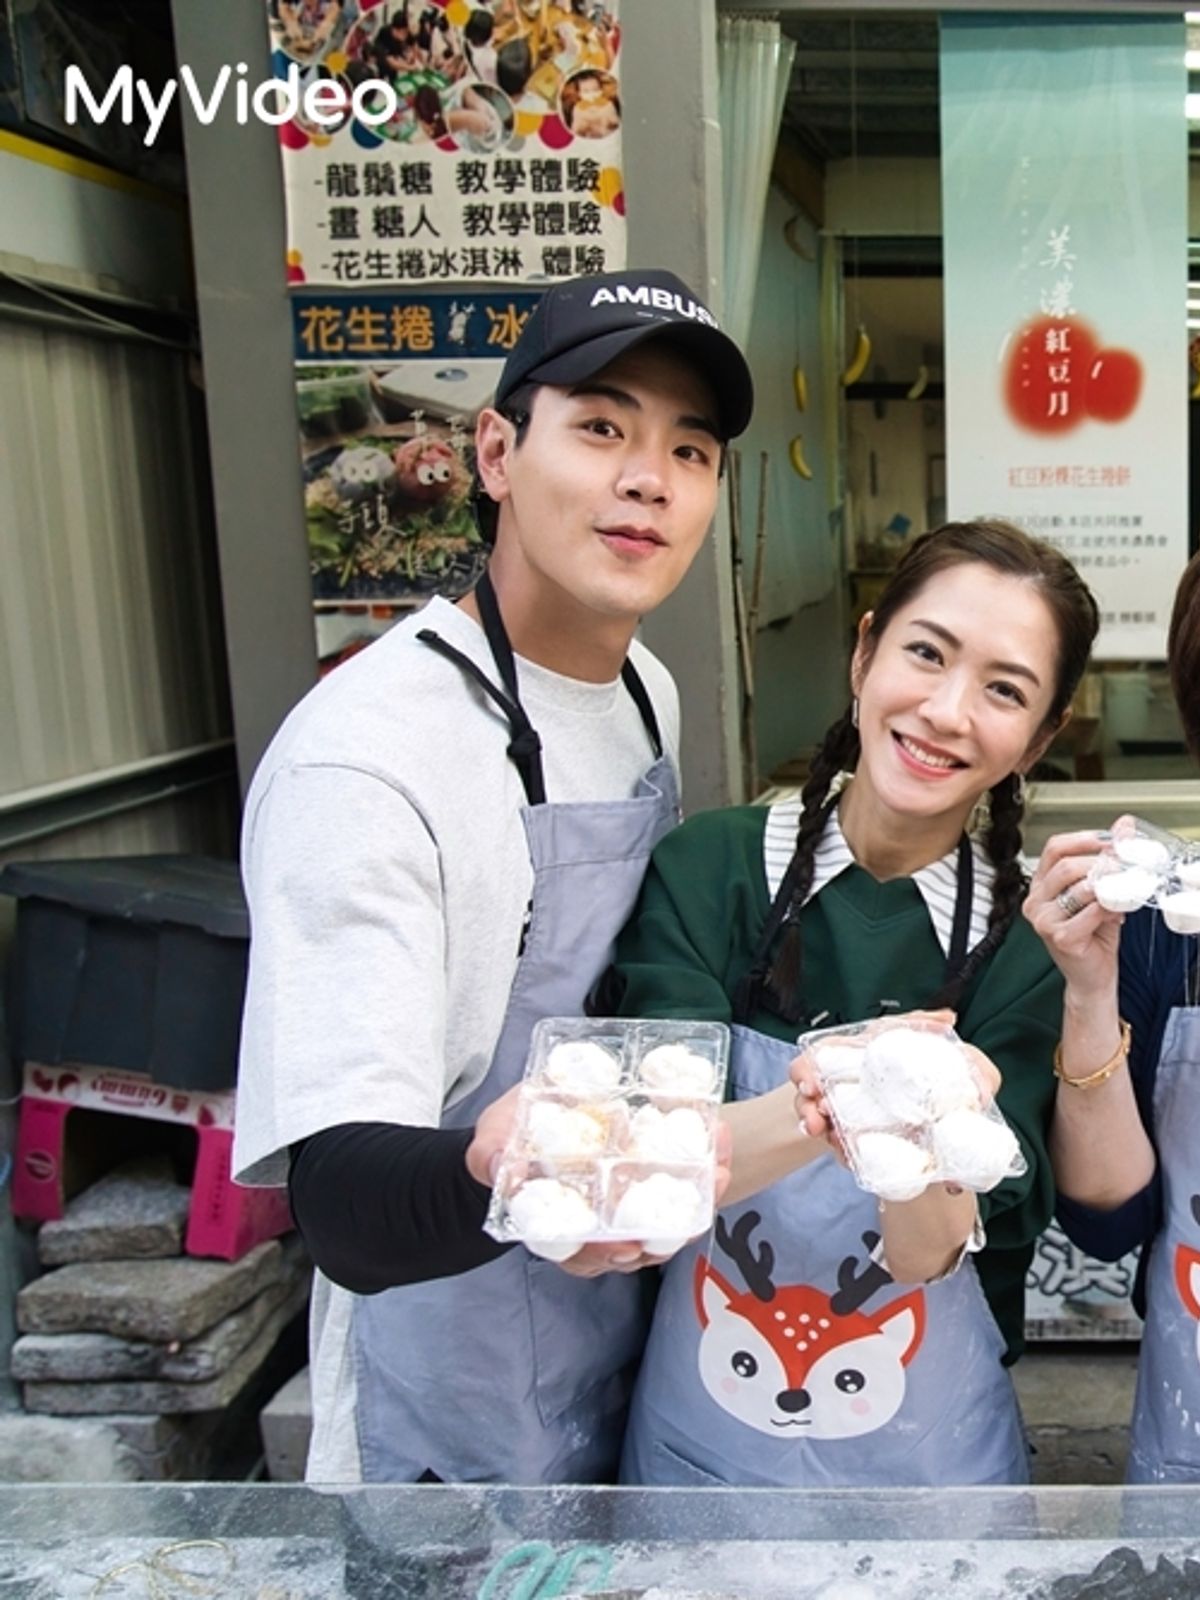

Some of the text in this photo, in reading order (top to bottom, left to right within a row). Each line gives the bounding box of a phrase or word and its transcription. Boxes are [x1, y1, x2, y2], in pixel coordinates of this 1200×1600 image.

[456, 158, 601, 194] 教學體驗
[463, 202, 601, 236] 教學體驗
[590, 285, 719, 329] AMBUS
[300, 304, 538, 352] 花生捲 冰
